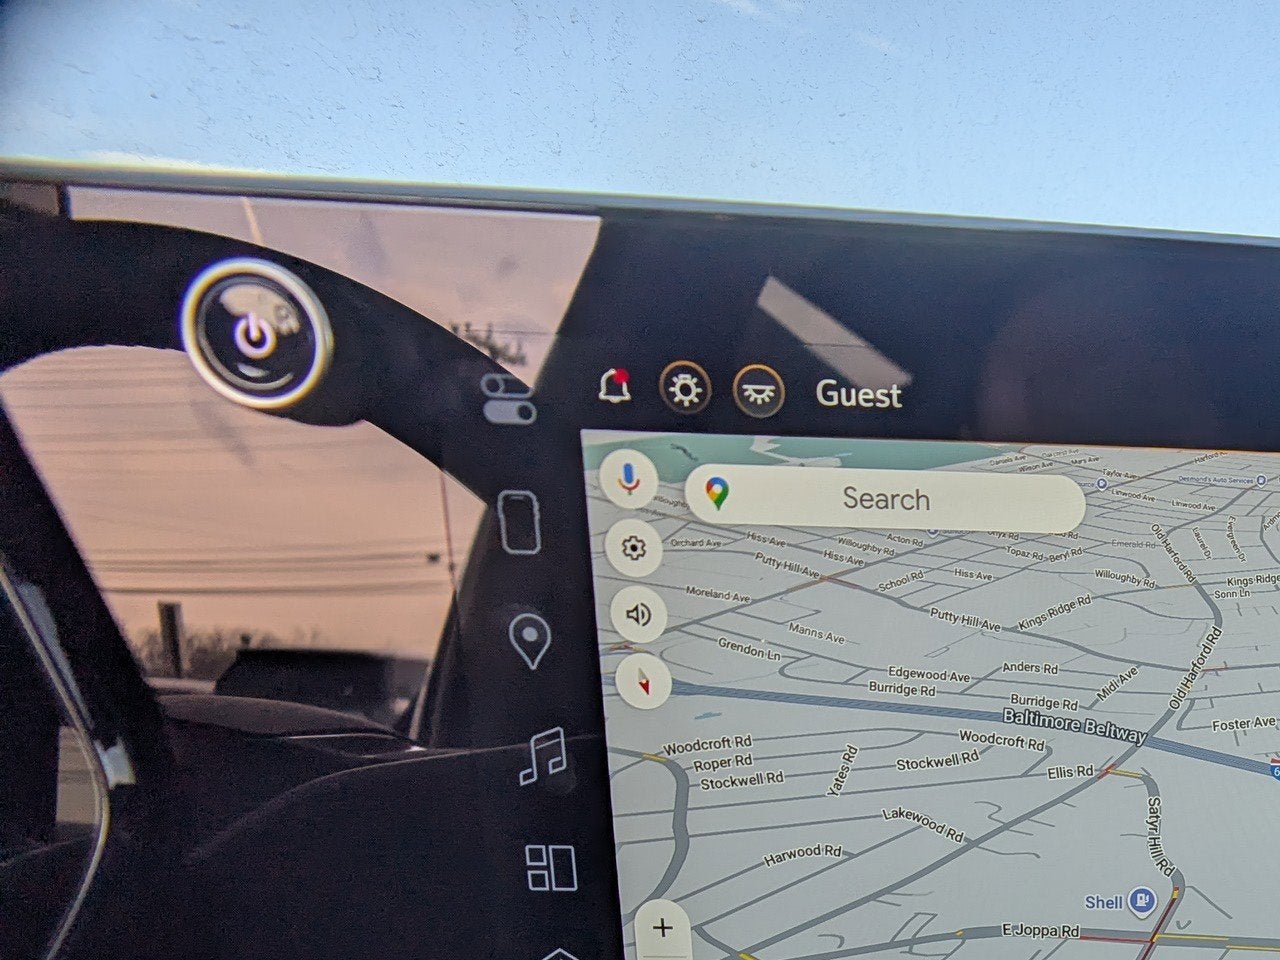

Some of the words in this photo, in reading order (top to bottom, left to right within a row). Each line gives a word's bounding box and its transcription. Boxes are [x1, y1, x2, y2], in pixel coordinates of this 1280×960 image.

[816, 379, 903, 409] Guest
[843, 486, 930, 512] Search
[837, 536, 885, 555] Willoughby
[886, 545, 896, 556] Rd
[886, 533, 911, 545] Acton
[912, 537, 924, 548] Rd
[823, 550, 844, 563] Hiss
[845, 555, 865, 568] Ave
[1151, 523, 1166, 543] Old
[1163, 540, 1188, 572] Harford
[1181, 567, 1196, 584] Rd
[755, 551, 782, 570] Putty
[783, 560, 801, 574] Hill
[801, 566, 820, 580] Ave
[954, 568, 975, 580] Hiss
[976, 571, 993, 582] Ave
[878, 574, 910, 592] School
[911, 570, 924, 582] Rd
[1094, 569, 1141, 587] Willoughby
[1143, 577, 1156, 590] Rd
[1226, 576, 1254, 588] Kings
[686, 585, 731, 601] Moreland
[732, 591, 751, 603] Ave
[929, 607, 960, 626] Putty
[961, 614, 980, 628] Hill
[980, 619, 1001, 633] Ave
[1017, 610, 1048, 632] Kings
[1046, 600, 1076, 619] Ridge
[1076, 593, 1092, 607] Rd
[788, 621, 823, 640] Manns
[824, 632, 846, 646] Ave
[718, 637, 765, 659] Grendon
[767, 649, 782, 662] Ln
[888, 666, 947, 682] Edgewood
[949, 670, 971, 683] Ave
[1003, 661, 1041, 674] Anders
[1043, 664, 1059, 675] Rd
[1117, 666, 1139, 685] Ave
[1169, 689, 1187, 711] Old
[1180, 644, 1213, 692] Harford
[1206, 625, 1223, 648] Rd
[869, 681, 918, 697] Burridge
[920, 685, 936, 697] Rd
[1010, 693, 1060, 710] Burridge
[1062, 699, 1079, 711] Rd
[1002, 707, 1082, 733] Baltimore
[1084, 718, 1149, 747] Beltway
[1212, 719, 1253, 732] Foster
[1253, 716, 1277, 728] Ave
[663, 736, 732, 757] Woodcroft
[734, 735, 753, 748] Rd
[959, 729, 1025, 748] Woodcroft
[1027, 739, 1046, 752] Rd
[693, 756, 733, 773] Roper
[735, 754, 754, 767] Rd
[826, 763, 850, 798] Yates
[842, 744, 860, 764] Rd
[896, 754, 960, 771] Stockwell
[961, 750, 981, 764] Rd
[700, 772, 765, 791] Stockwell
[766, 770, 785, 784] Rd
[1047, 766, 1074, 780] Ellis
[1076, 765, 1094, 777] Rd
[882, 808, 946, 835] Lakewood
[946, 828, 965, 844] Rd
[1145, 797, 1161, 834] Satyr
[763, 844, 822, 868] Harwood
[824, 844, 843, 858] Rd
[1148, 836, 1165, 861] Hill
[1156, 858, 1176, 878] Rd
[1085, 895, 1123, 910] Shell
[1003, 923, 1012, 936] E
[1016, 924, 1059, 939] Joppa
[1061, 925, 1080, 938] Rd
